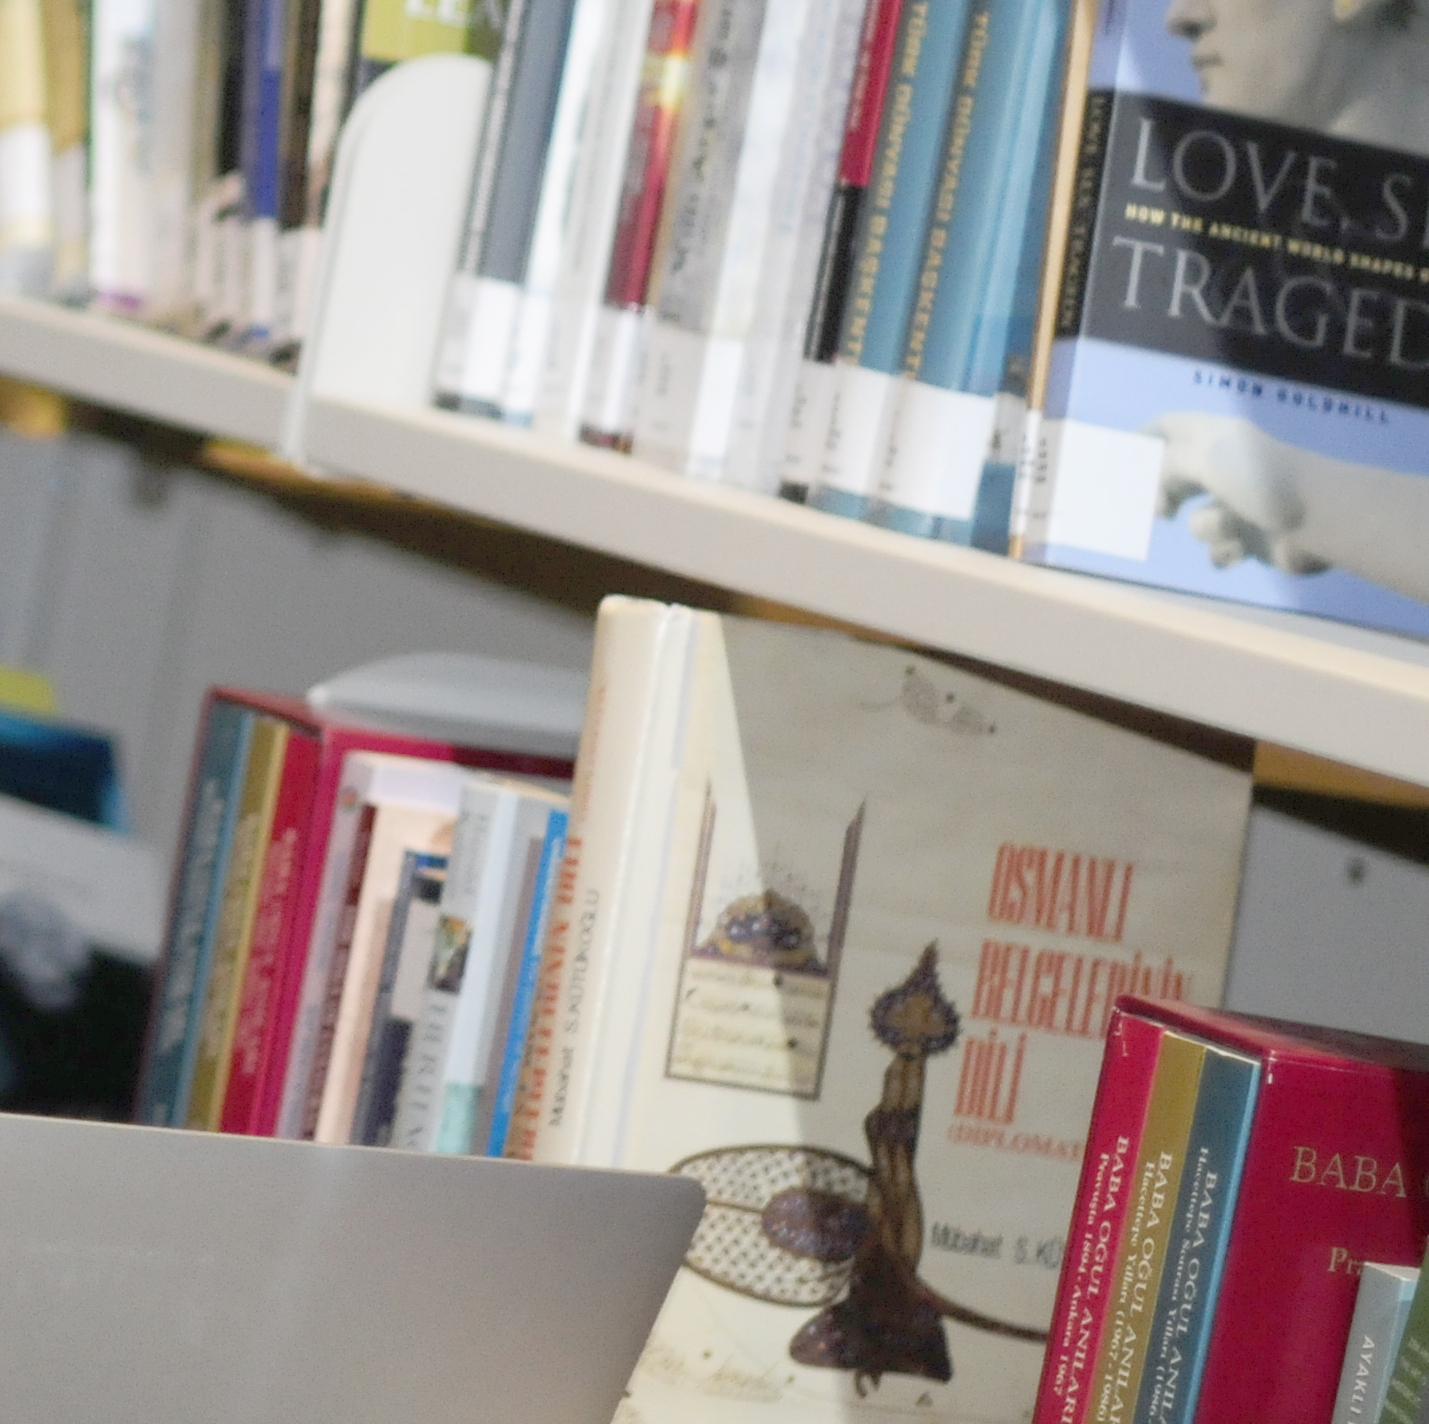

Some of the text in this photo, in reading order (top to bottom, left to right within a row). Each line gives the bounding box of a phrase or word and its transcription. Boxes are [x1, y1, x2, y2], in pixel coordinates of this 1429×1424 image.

[1125, 202, 1166, 225] HOW
[1171, 211, 1203, 233] THE
[1209, 222, 1283, 250] ANCIENT
[1287, 238, 1345, 265] WORLD
[1375, 172, 1429, 249] S
[1193, 369, 1390, 424] SIMON GOLDHILL
[1103, 1135, 1129, 1212] BABA
[1131, 1162, 1155, 1247] Hacettepe
[1147, 1151, 1173, 1228] BABA
[1185, 1146, 1209, 1233] Hacettepe
[1192, 1171, 1218, 1248] BABA
[1290, 1146, 1407, 1198] BABA
[1087, 1221, 1112, 1295] OĞUL
[1130, 1237, 1155, 1316] OĞUL
[1061, 1285, 1082, 1348] Ankara
[1176, 1258, 1201, 1337] OĞUL
[1053, 1355, 1068, 1396] 1967
[1349, 1335, 1376, 1413] AYAKLI
